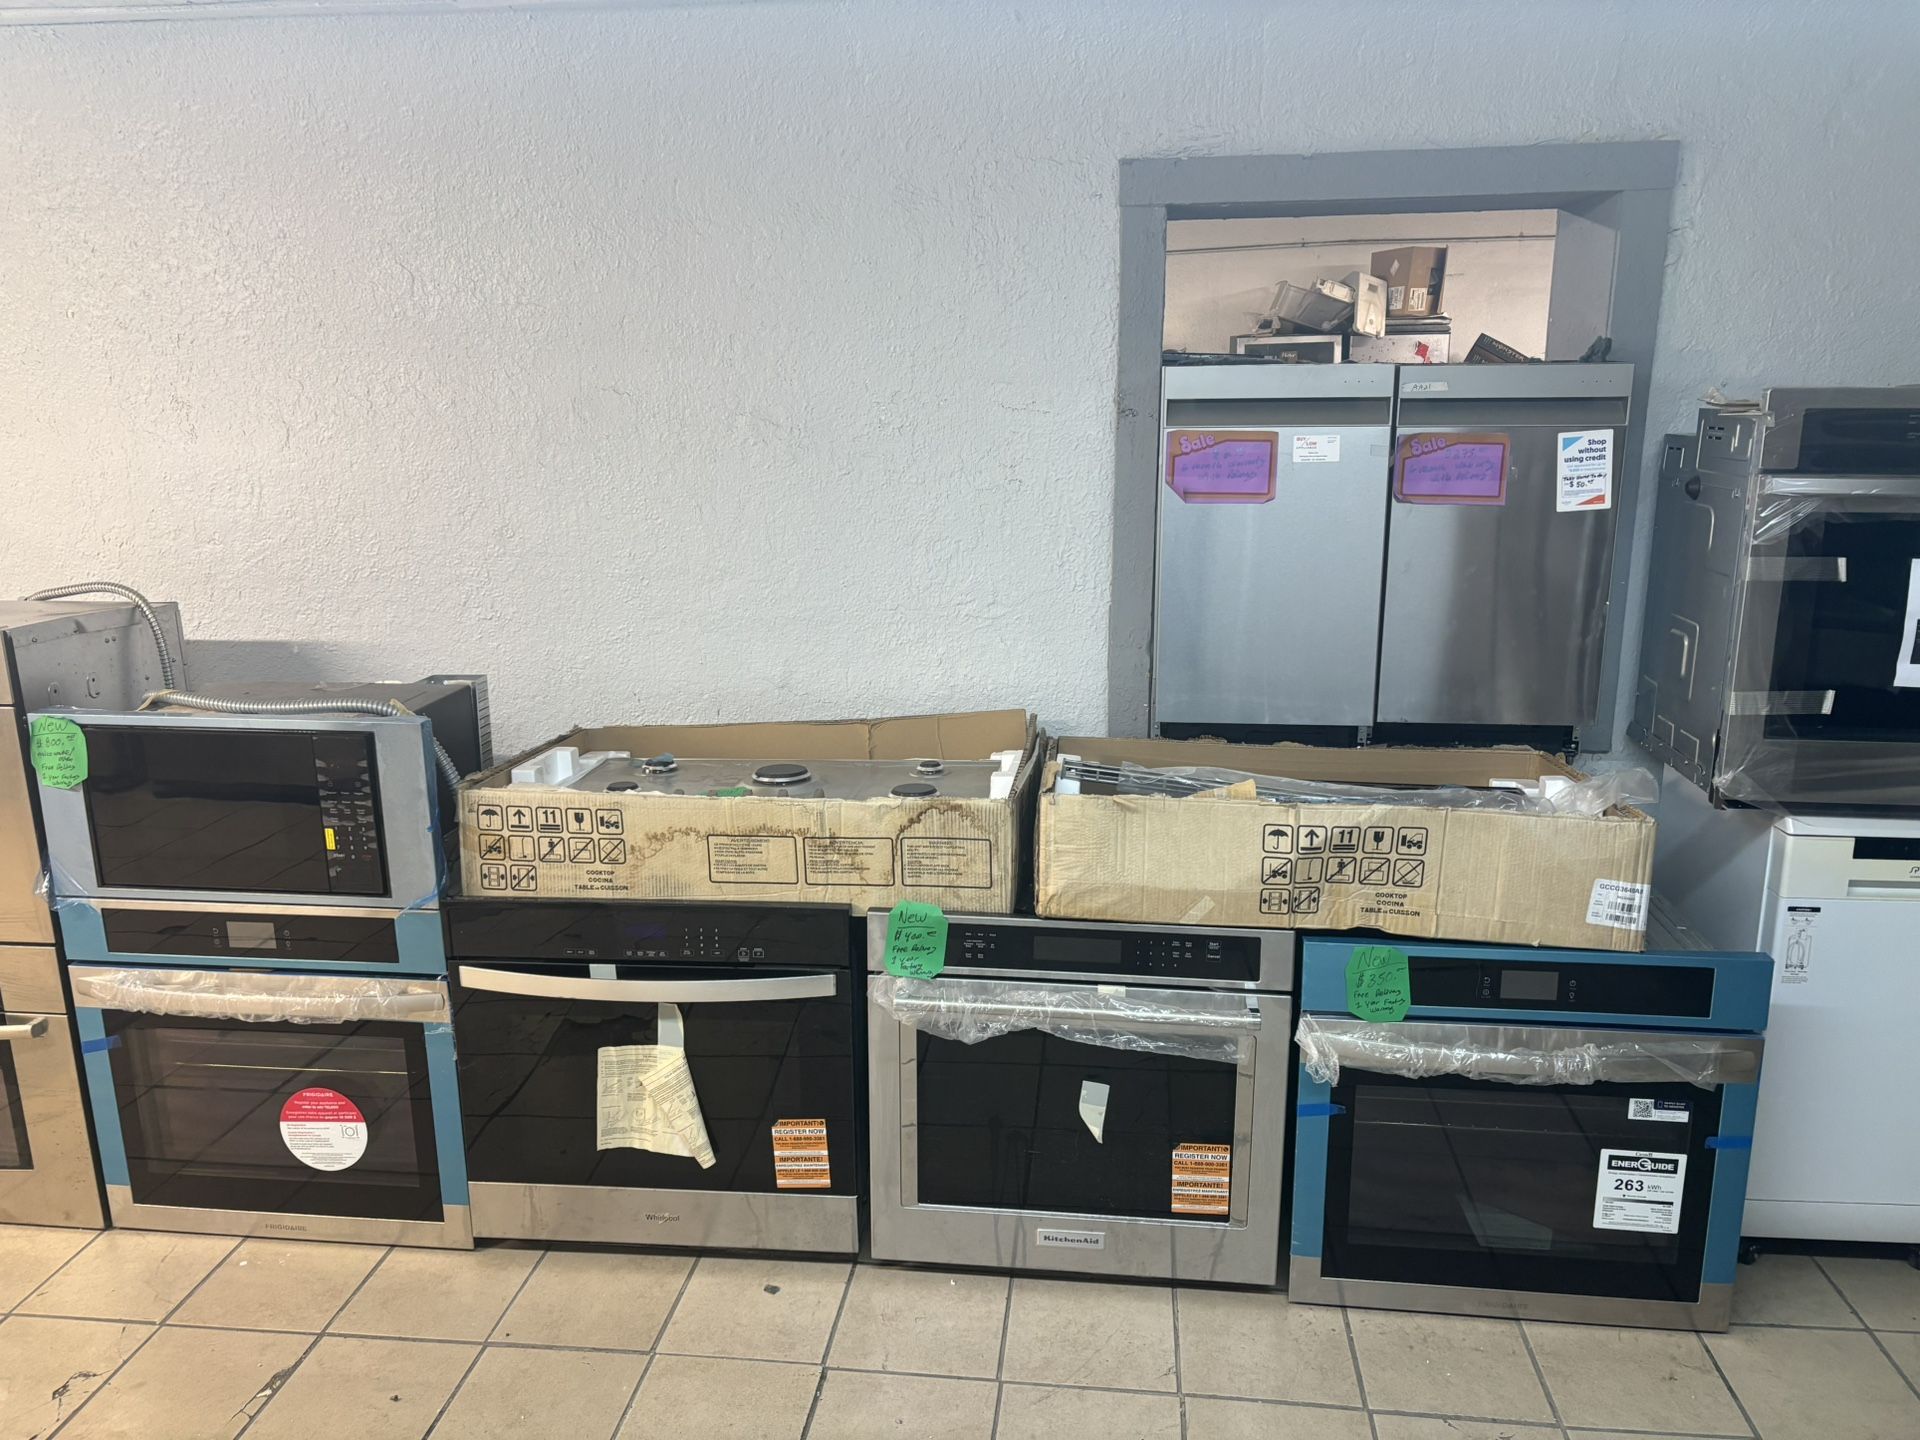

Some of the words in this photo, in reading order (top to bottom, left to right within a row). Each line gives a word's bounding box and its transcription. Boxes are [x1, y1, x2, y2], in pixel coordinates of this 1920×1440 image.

[1180, 434, 1215, 454] Sale
[1411, 438, 1446, 457] Sale
[1578, 446, 1607, 454] without
[38, 715, 69, 732] New
[1376, 899, 1404, 907] COCINA
[898, 907, 928, 924] New
[1360, 906, 1382, 914] TABLE
[1388, 908, 1420, 917] CUISSON
[892, 945, 908, 953] Free
[1353, 990, 1369, 999] Free
[1614, 1178, 1644, 1192] 263
[645, 1213, 680, 1223] Whirlpool
[1043, 1235, 1099, 1244] KitchenAid
